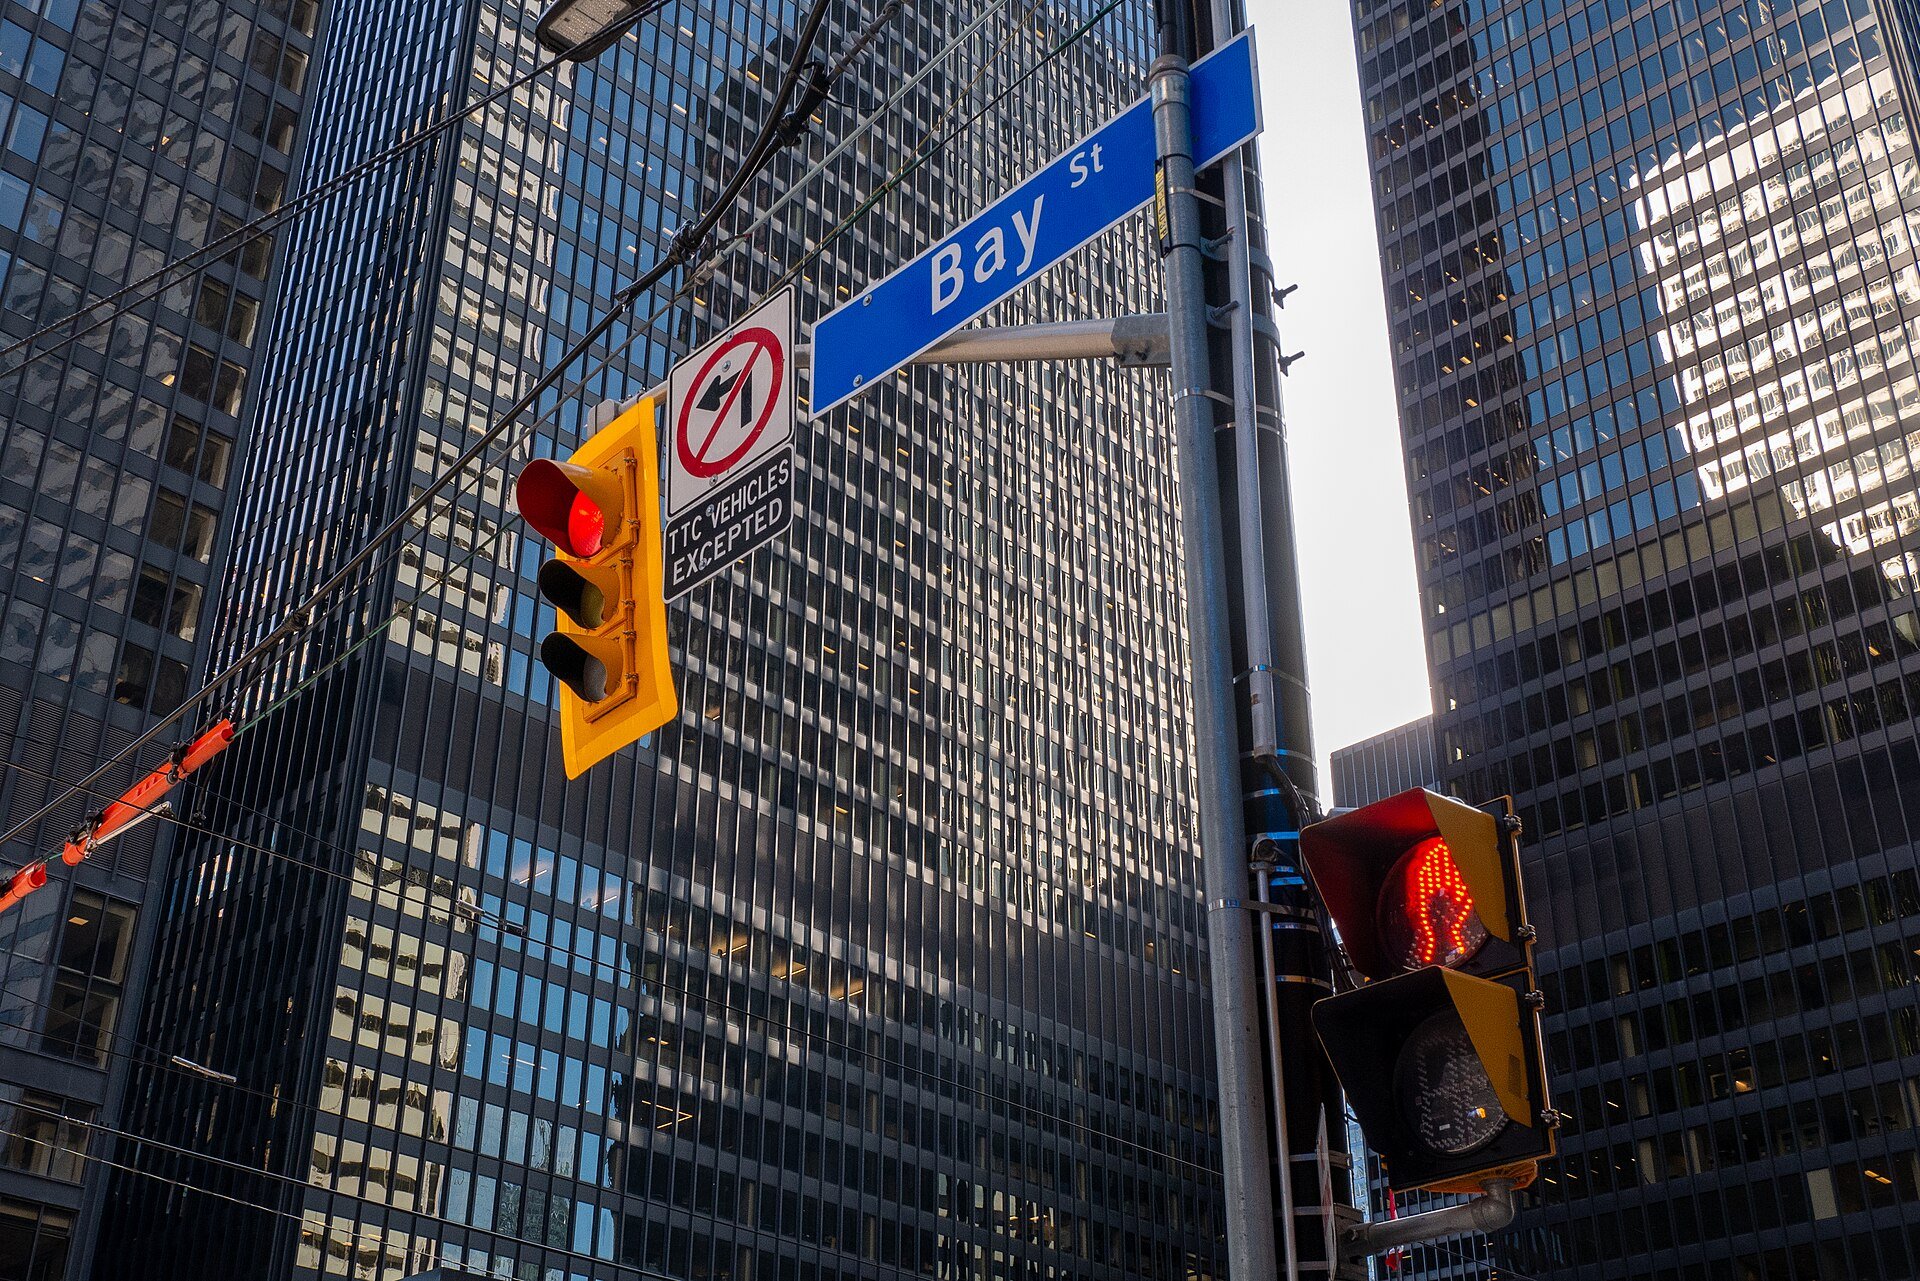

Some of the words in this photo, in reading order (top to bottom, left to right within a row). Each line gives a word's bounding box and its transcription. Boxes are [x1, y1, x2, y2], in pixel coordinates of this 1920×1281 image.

[931, 194, 1044, 315] Bay
[1069, 143, 1104, 188] St
[669, 515, 702, 554] TTC
[710, 458, 789, 529] VEHICLES
[673, 498, 783, 586] EXCEPTED
